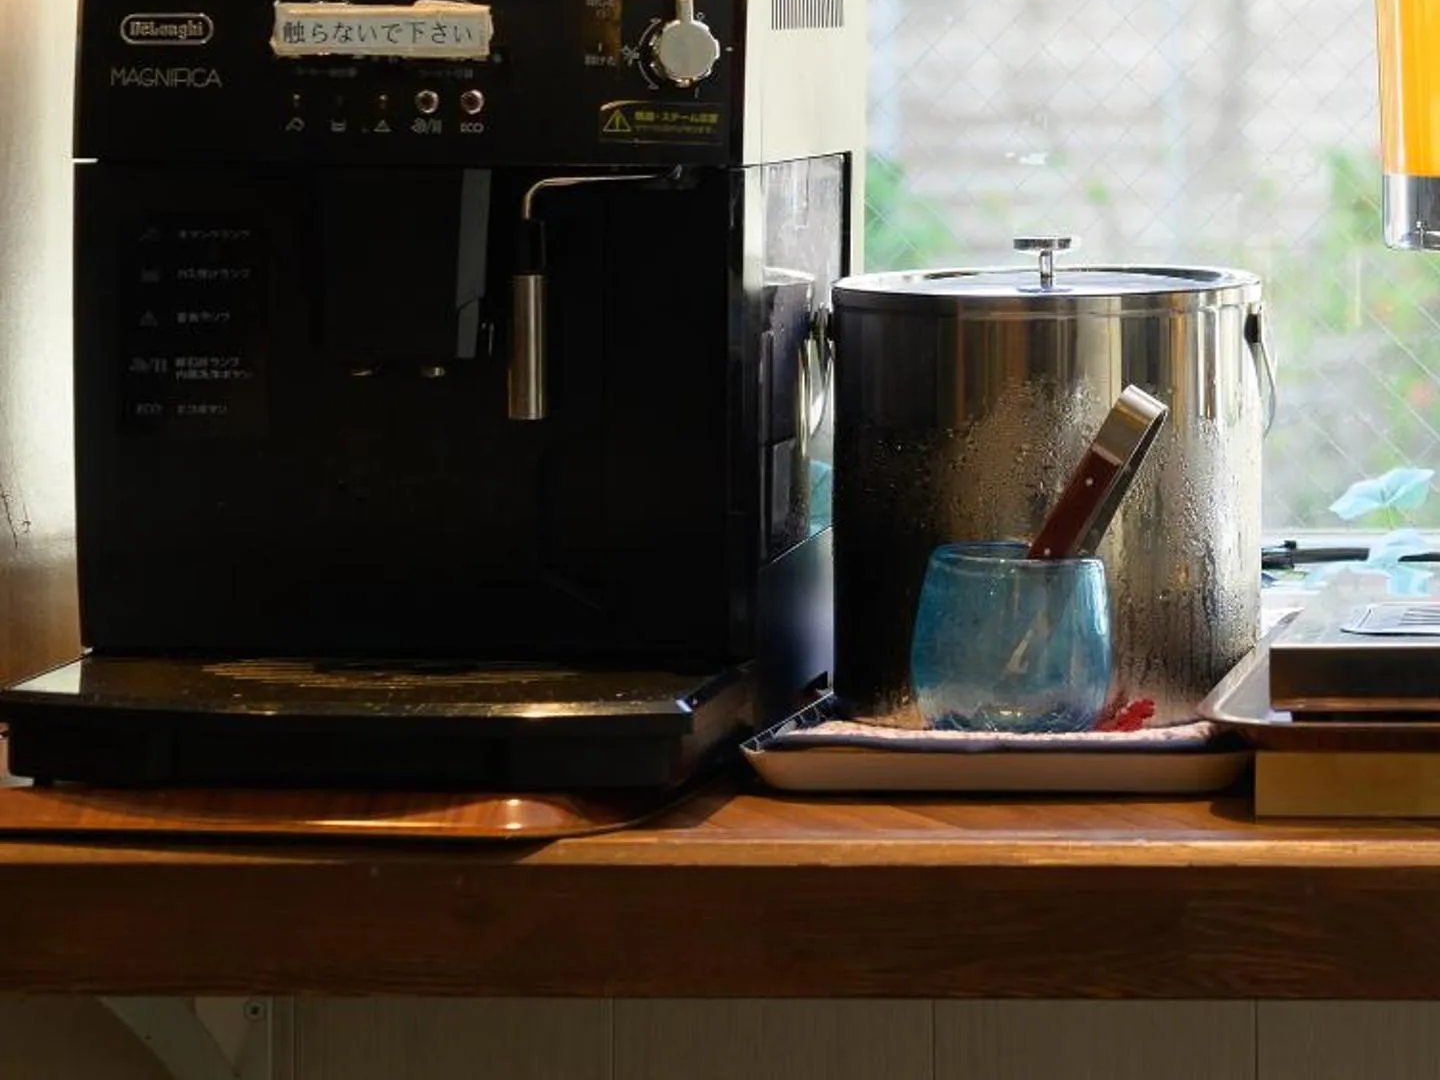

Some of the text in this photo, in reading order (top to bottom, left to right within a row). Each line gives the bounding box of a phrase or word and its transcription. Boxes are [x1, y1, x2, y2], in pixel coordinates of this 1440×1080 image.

[283, 21, 473, 44] 触らないで下さい
[109, 65, 223, 89] MAGNIFICA
[460, 122, 485, 134] ECO
